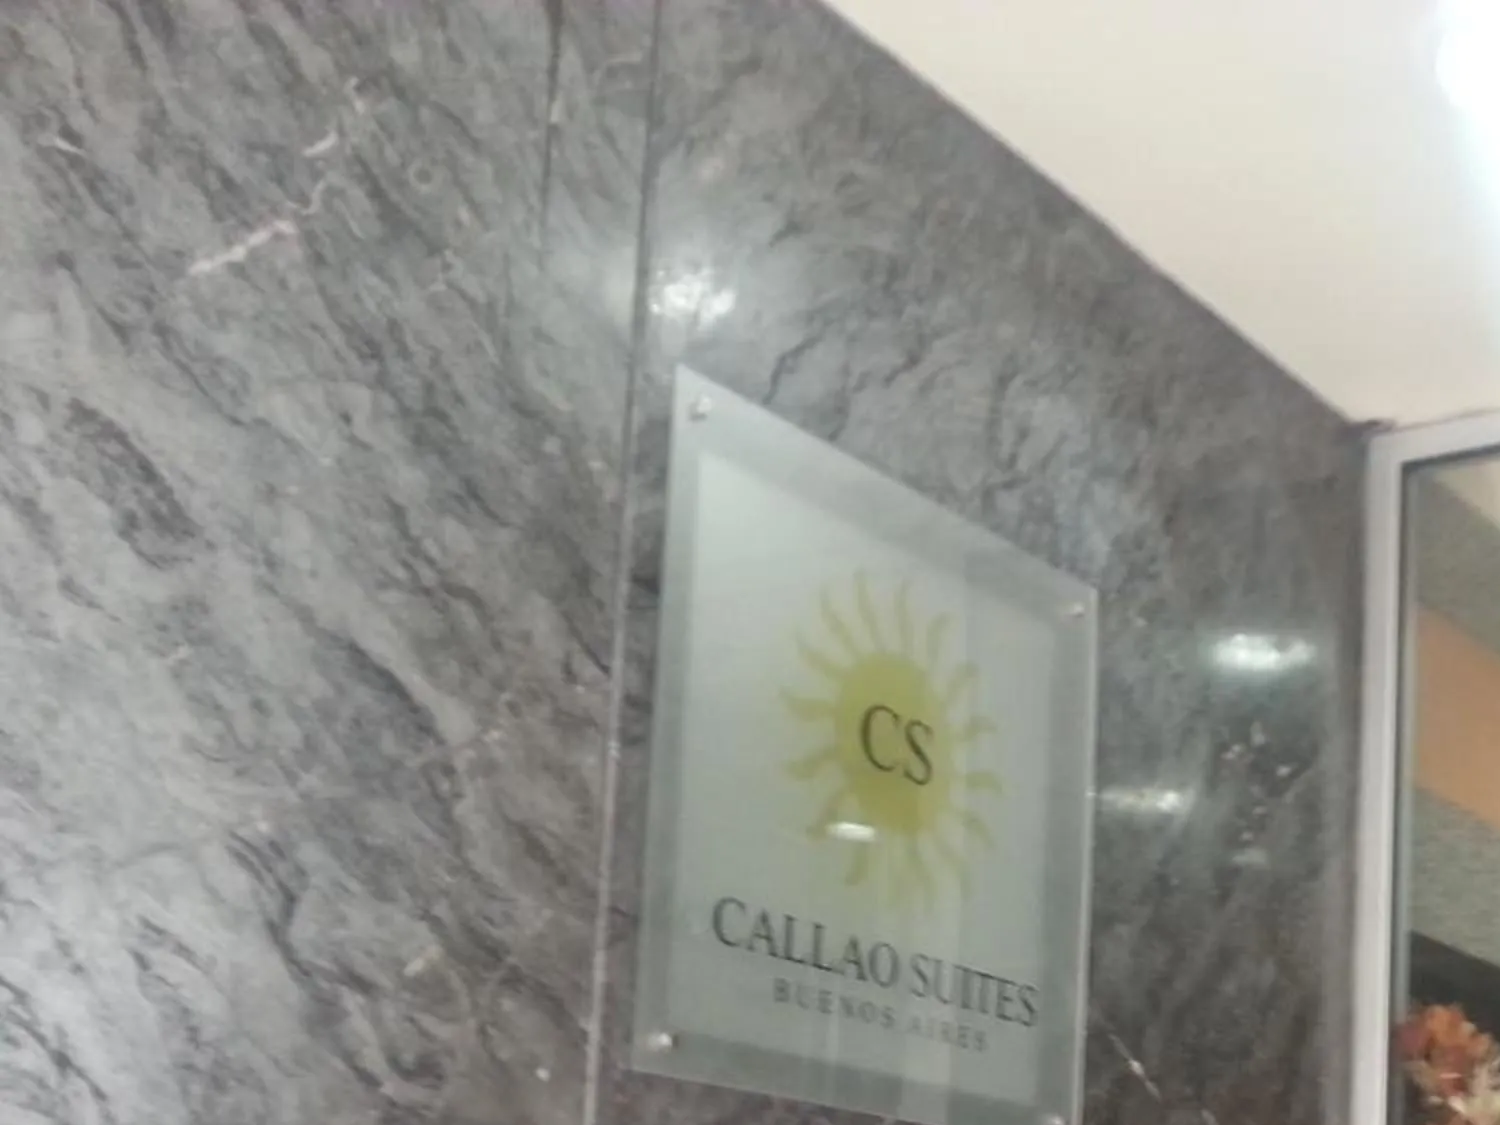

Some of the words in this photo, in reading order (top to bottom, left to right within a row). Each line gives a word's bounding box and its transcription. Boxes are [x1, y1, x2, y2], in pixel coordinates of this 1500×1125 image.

[860, 704, 935, 786] CS
[711, 897, 900, 988] CALLAO
[909, 953, 1038, 1027] SUITES
[773, 977, 897, 1030] BUENOS
[906, 1014, 986, 1052] AIRES
